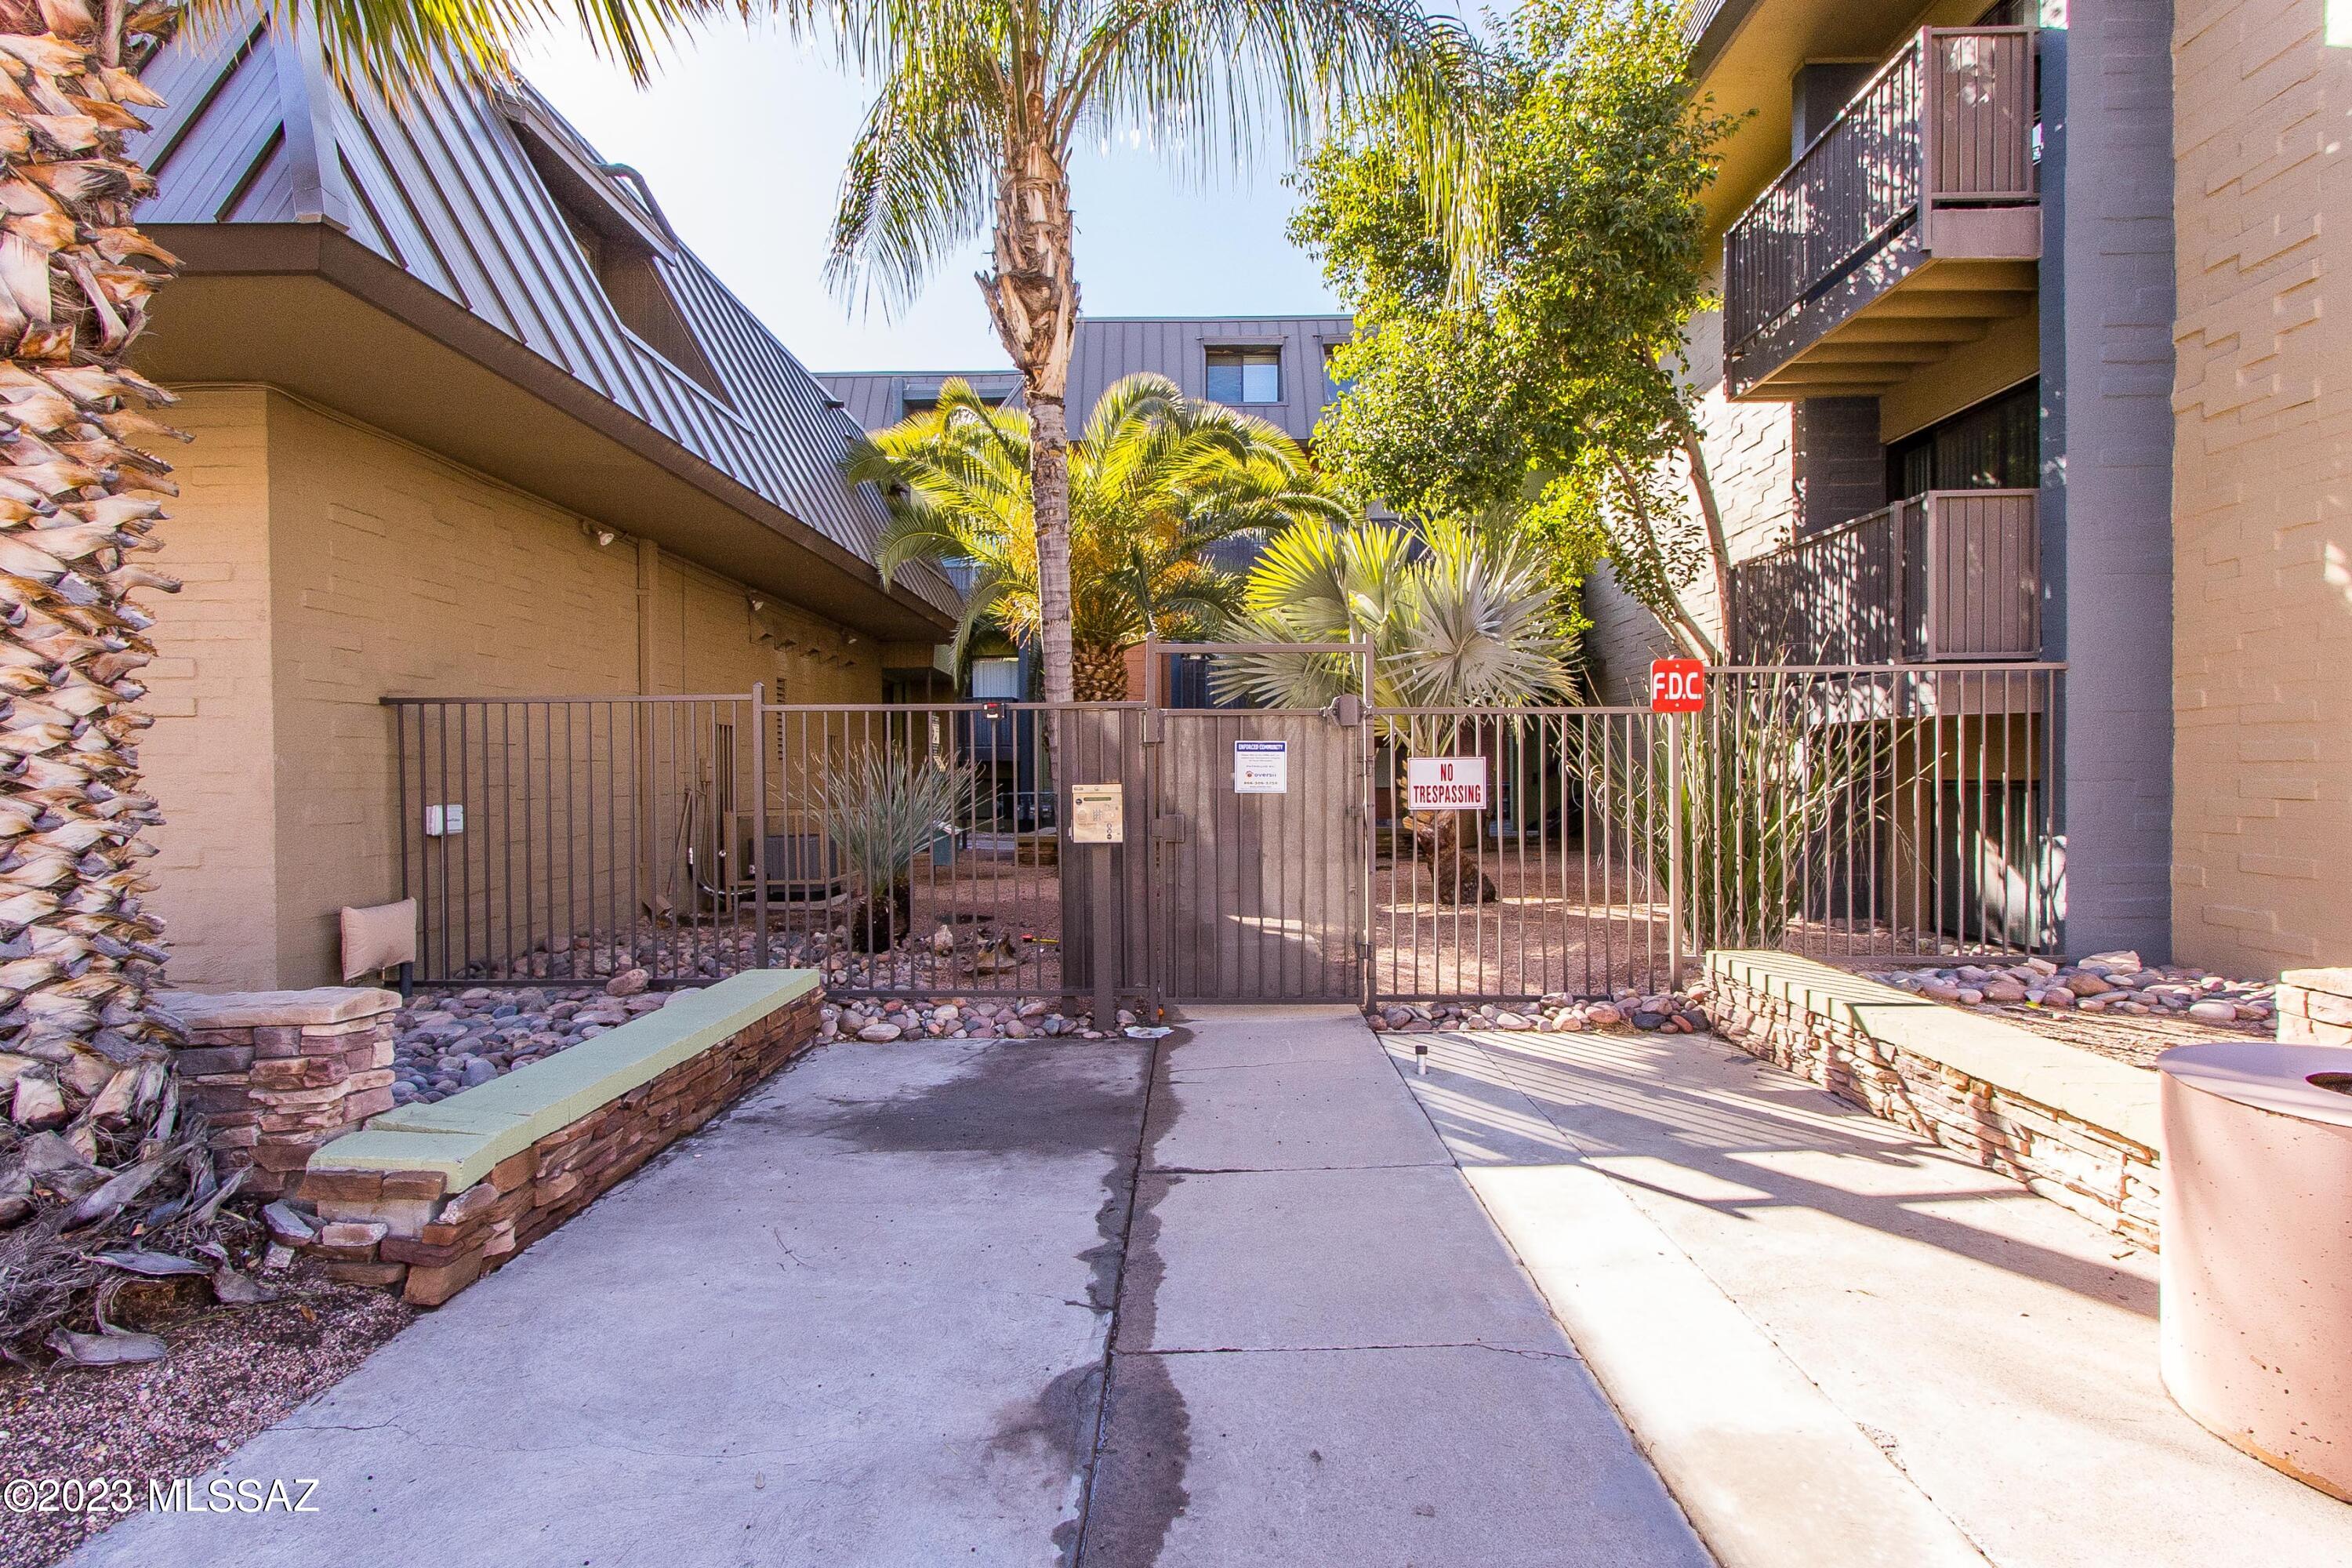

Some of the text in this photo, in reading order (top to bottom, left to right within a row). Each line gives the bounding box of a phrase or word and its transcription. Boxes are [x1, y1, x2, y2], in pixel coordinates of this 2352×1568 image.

[1653, 672, 1702, 700] F.D.C.
[1440, 764, 1454, 782] NO
[1414, 785, 1481, 804] TRESPASSING
